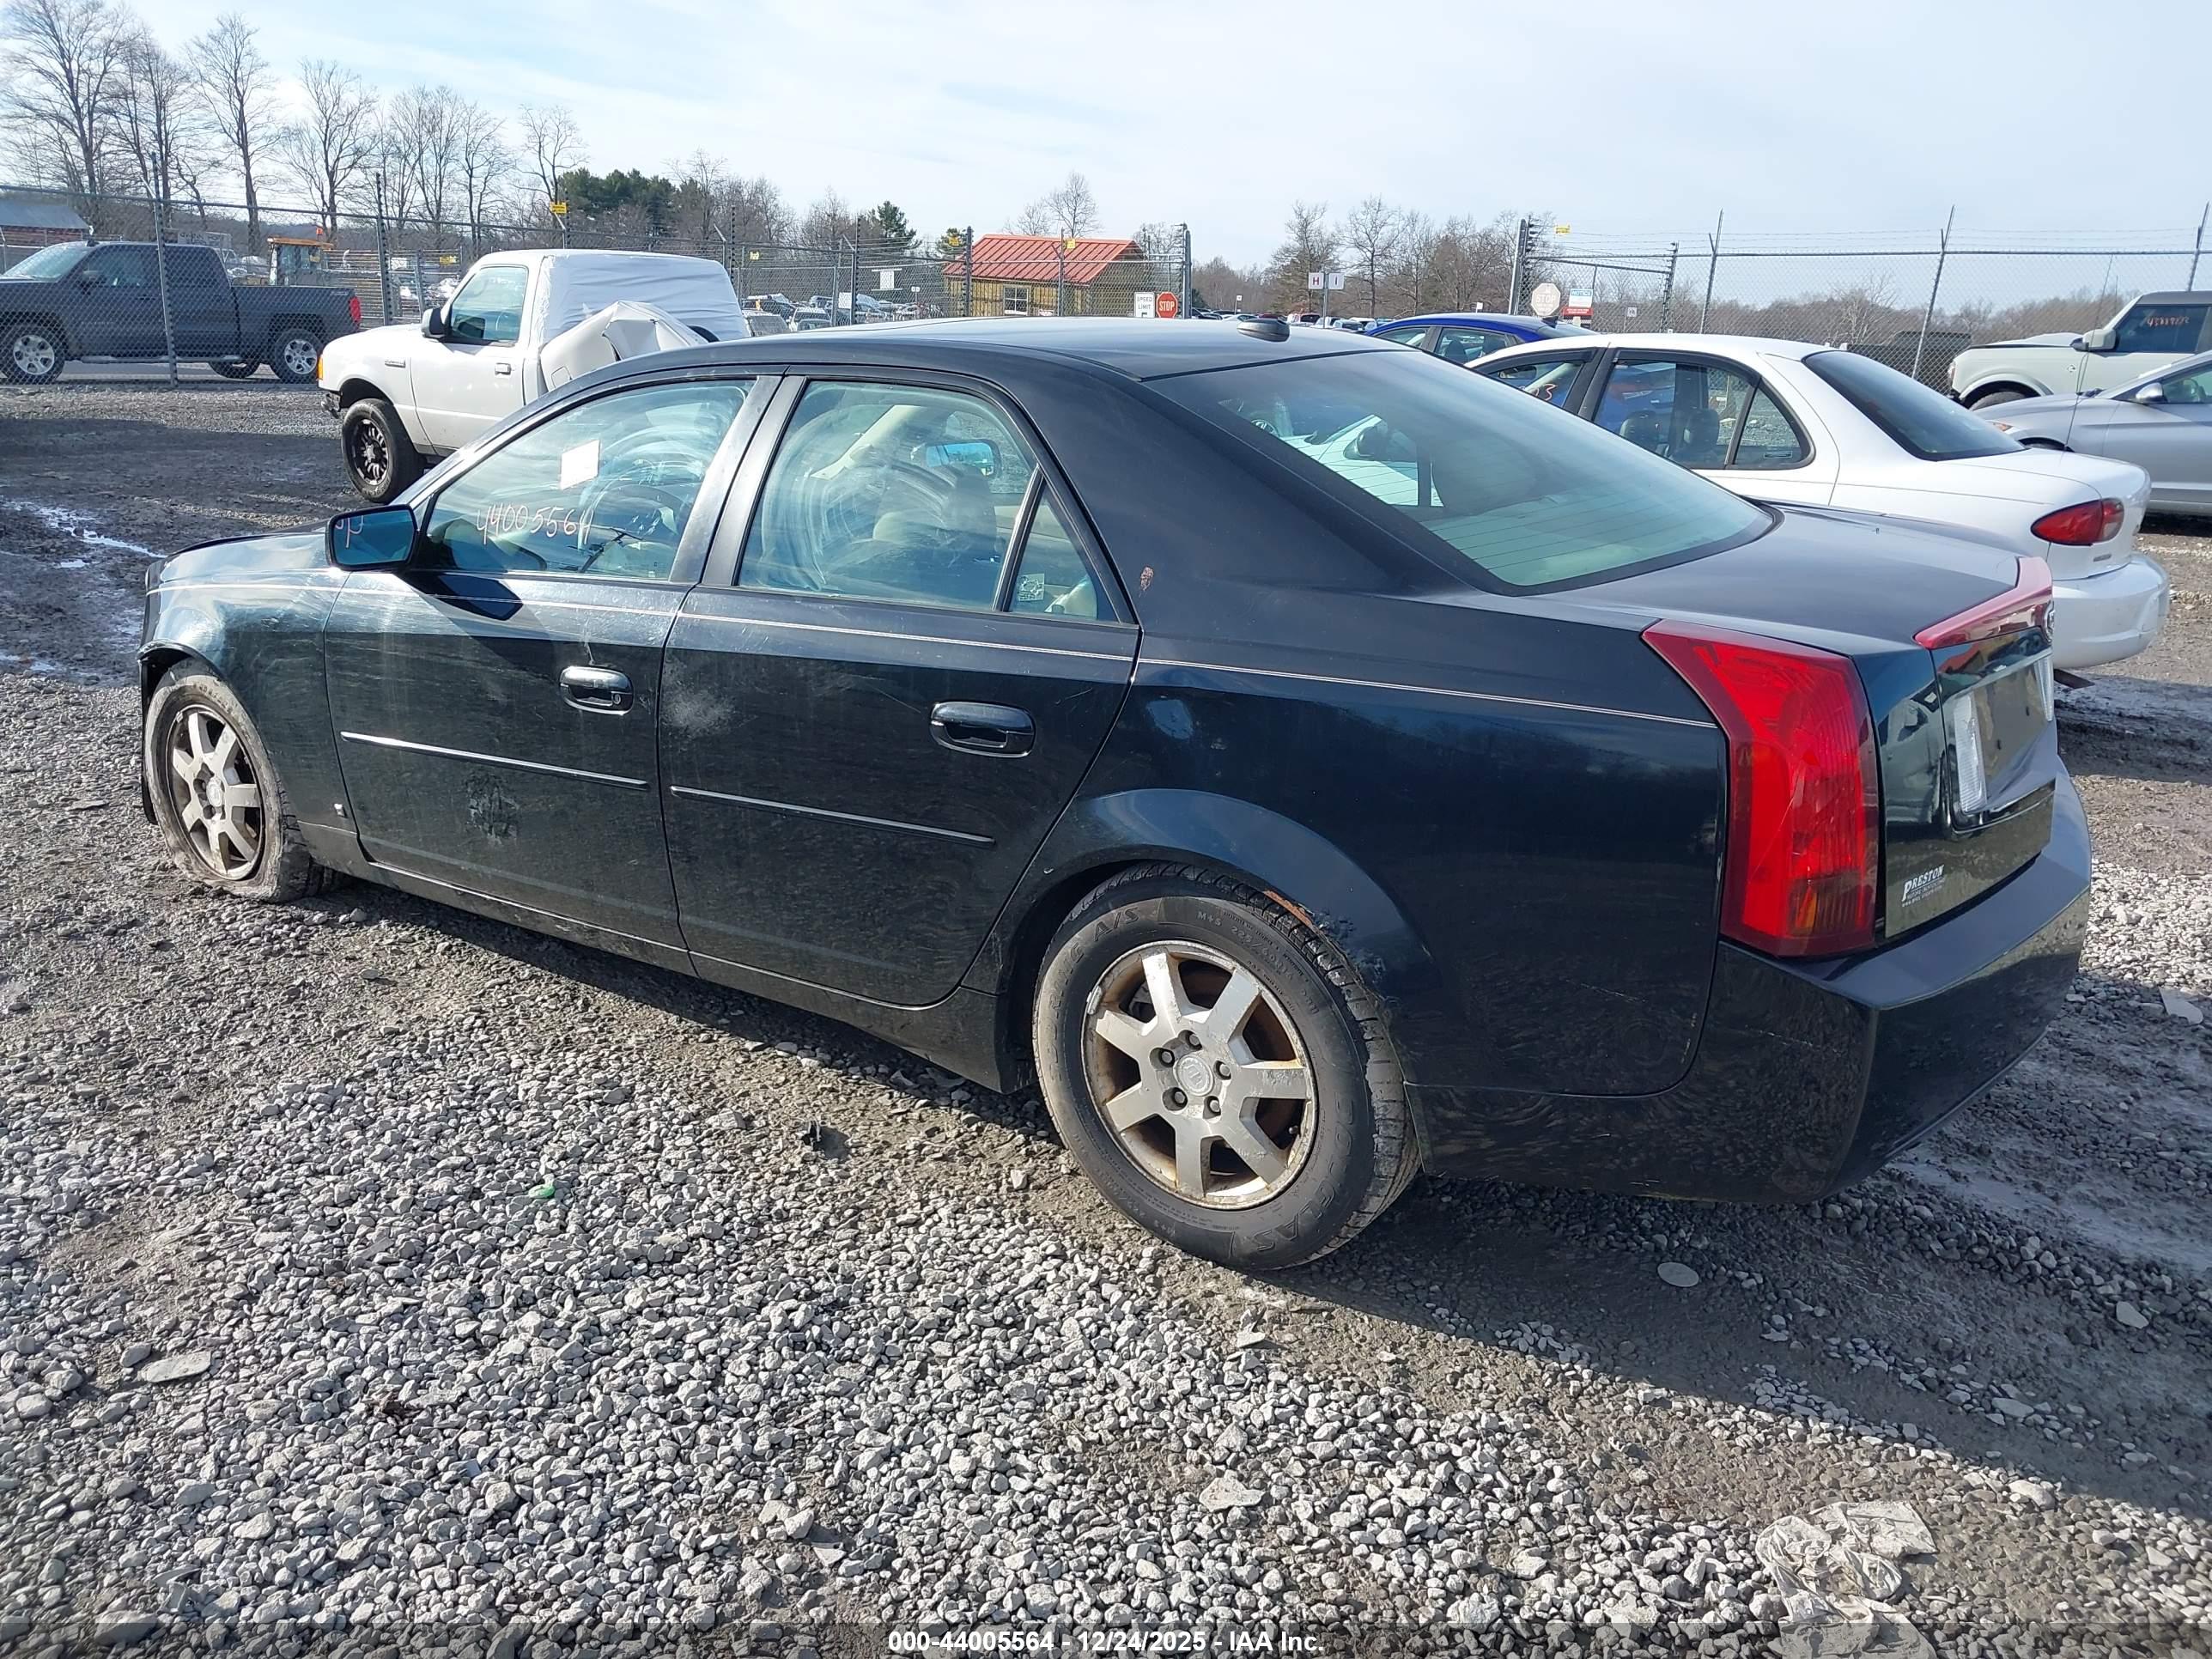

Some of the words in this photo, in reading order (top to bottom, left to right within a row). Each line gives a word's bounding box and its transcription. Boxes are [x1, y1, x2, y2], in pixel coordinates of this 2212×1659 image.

[1159, 301, 1175, 312] STOP
[476, 501, 593, 546] 44005564
[1901, 864, 1945, 902] PRESTON
[1093, 906, 1140, 942] A/S
[1196, 910, 1223, 927] M+S
